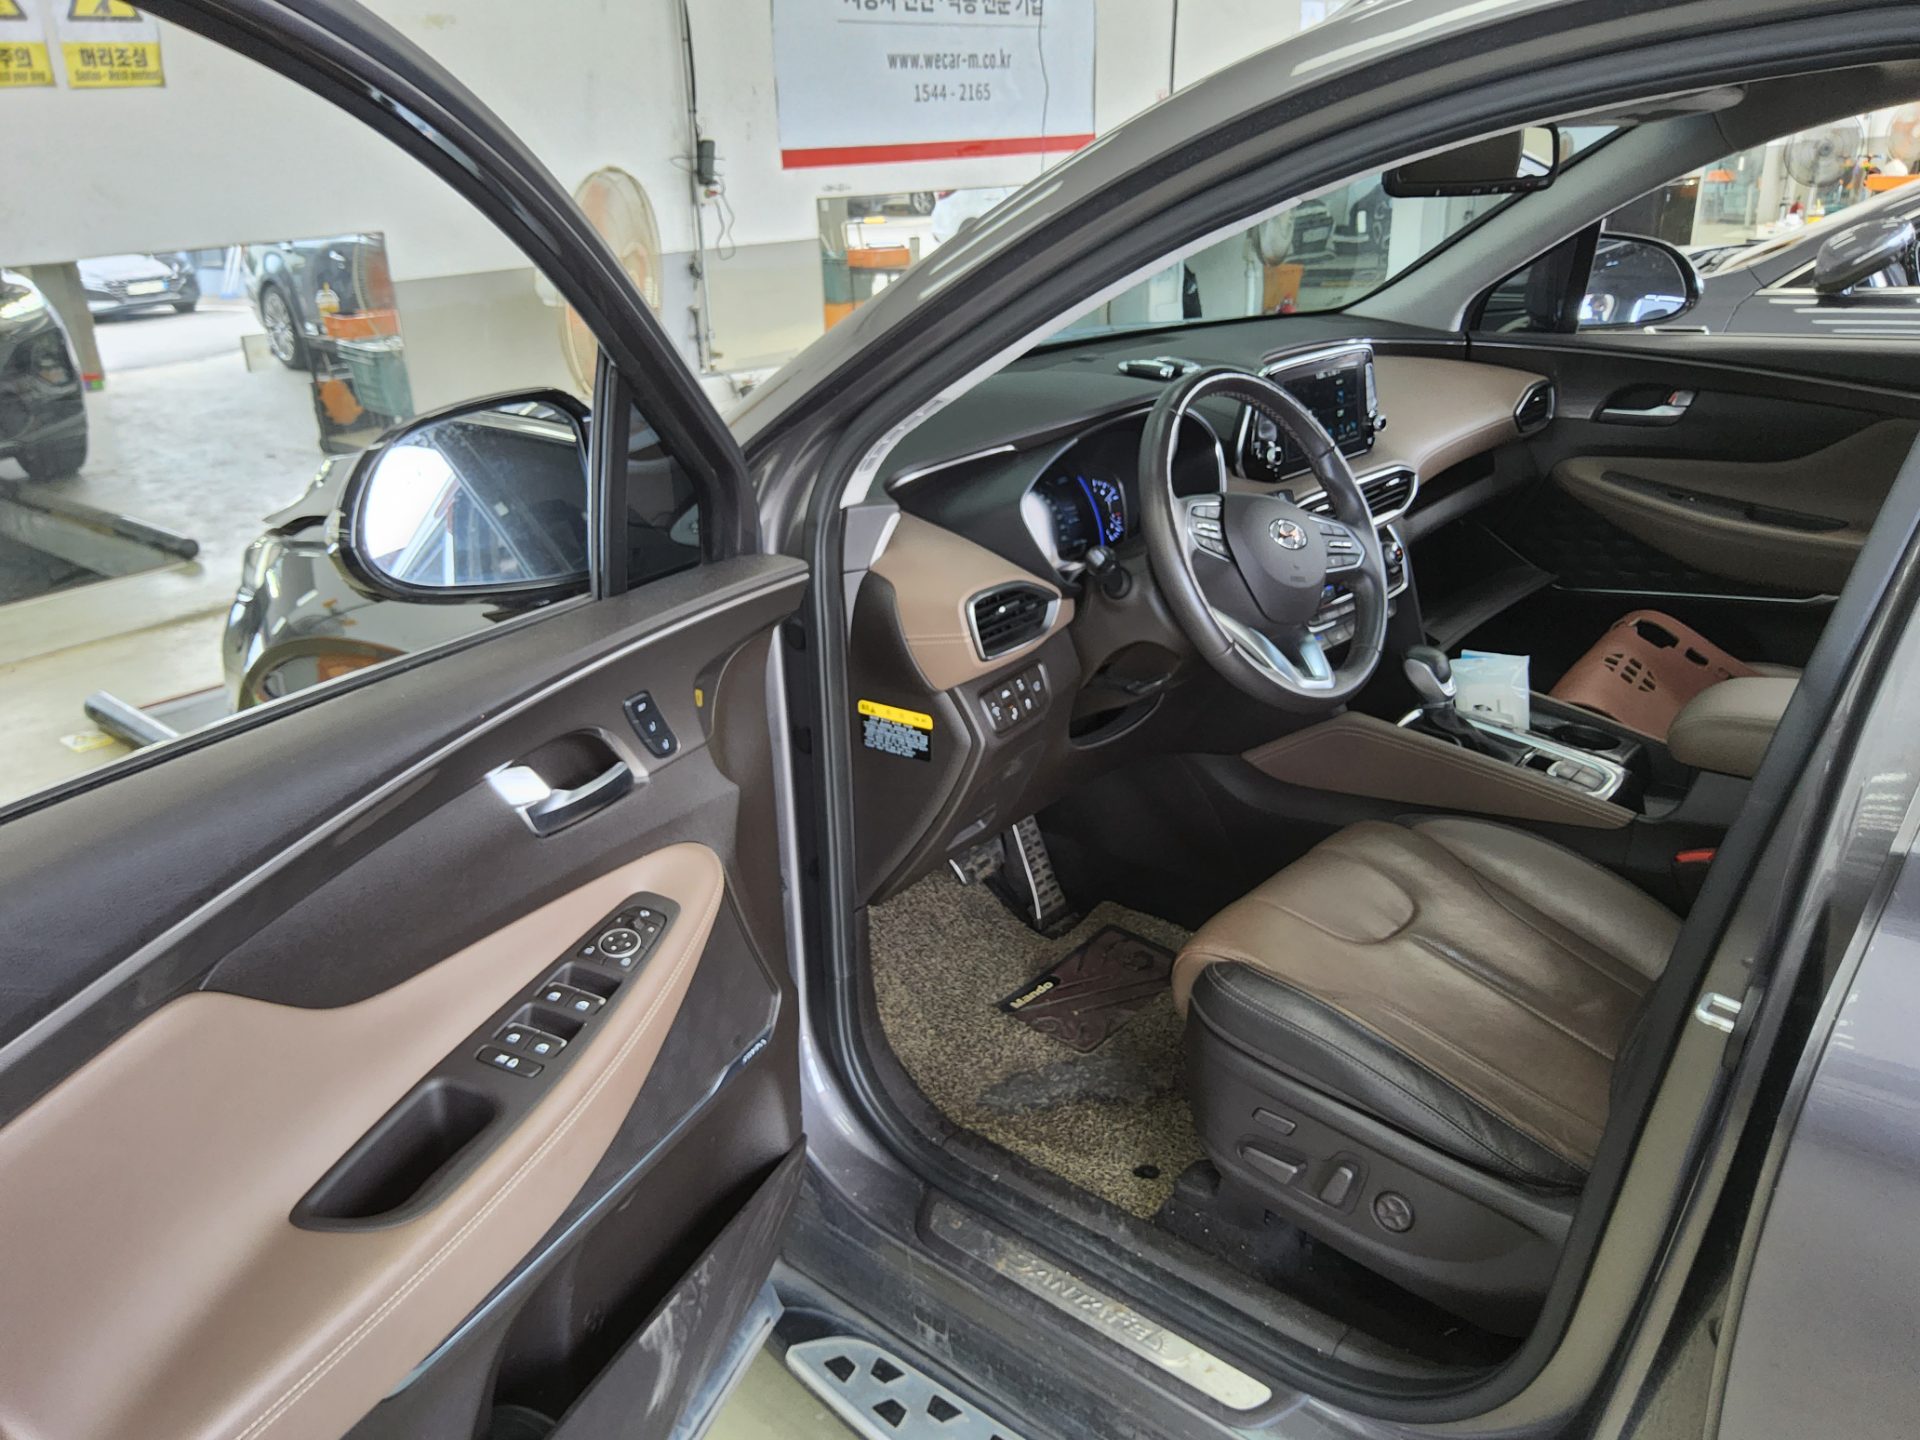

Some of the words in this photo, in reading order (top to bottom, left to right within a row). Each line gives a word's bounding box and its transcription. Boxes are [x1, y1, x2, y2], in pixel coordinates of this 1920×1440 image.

[79, 47, 149, 69] 머리조심
[887, 48, 1012, 70] www.wecar-m.co.kr
[914, 83, 947, 102] 1544
[959, 83, 991, 101] 2165
